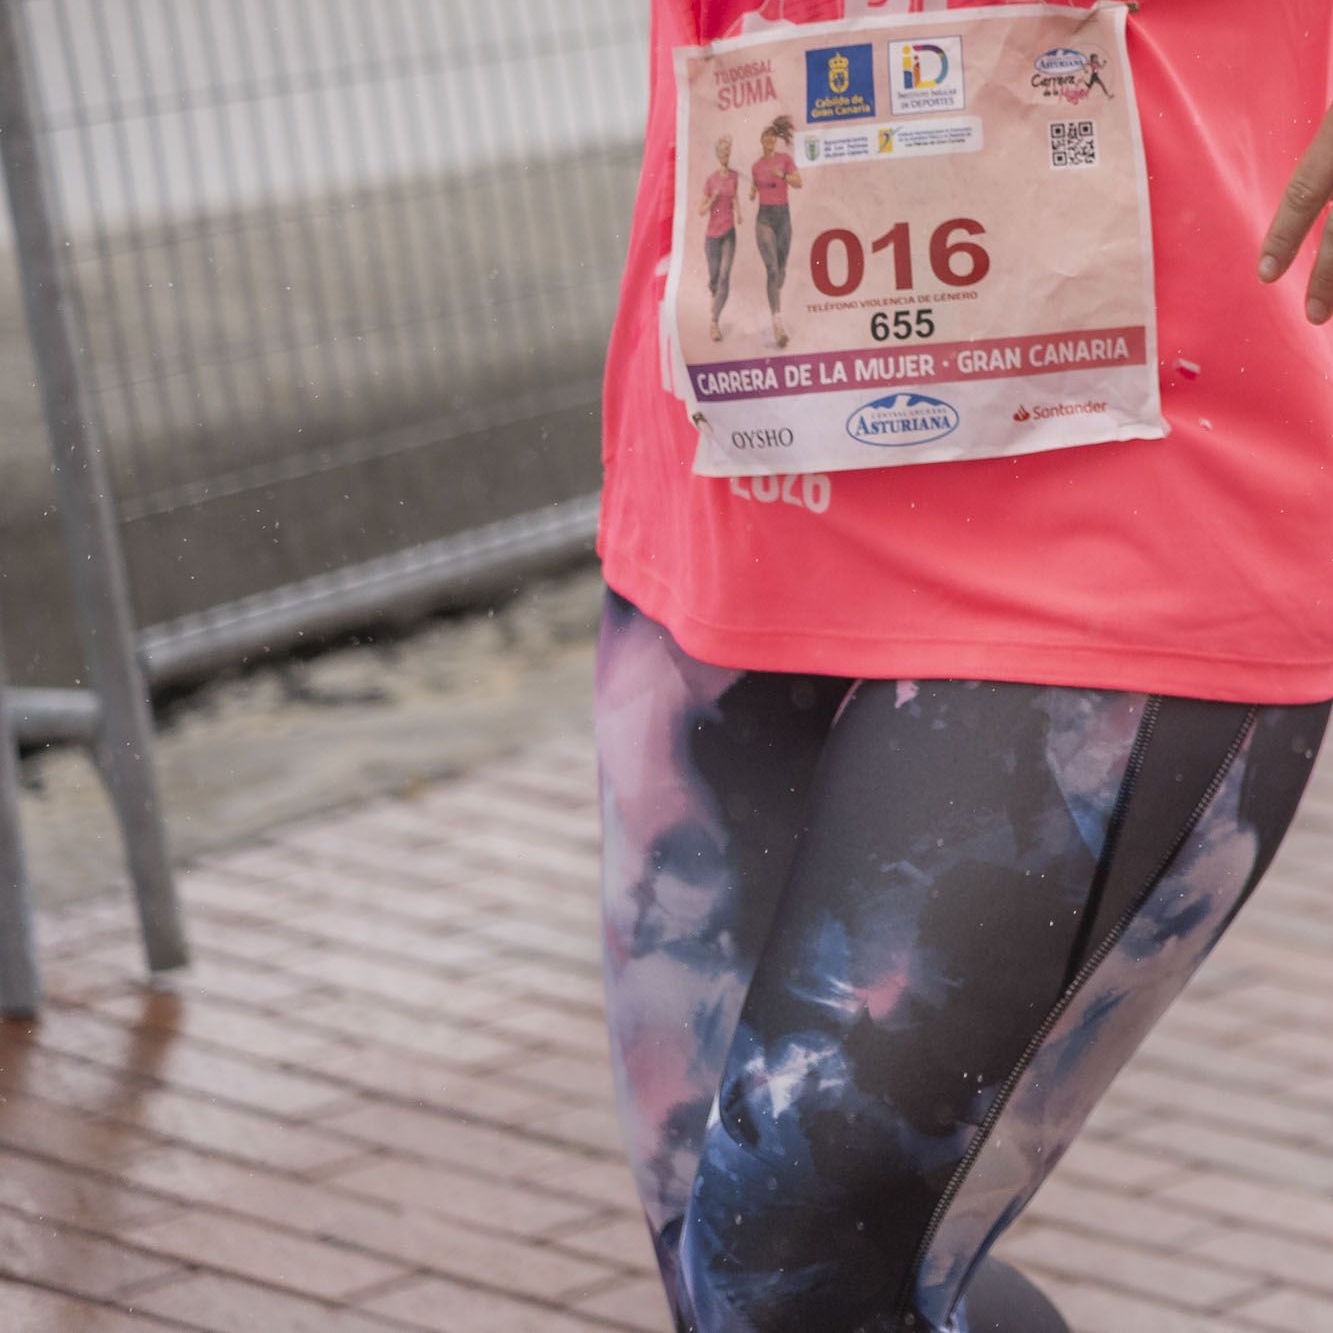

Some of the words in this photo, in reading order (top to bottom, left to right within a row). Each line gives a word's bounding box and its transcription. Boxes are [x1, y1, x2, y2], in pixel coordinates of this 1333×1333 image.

[717, 76, 777, 111] SUMA
[809, 218, 990, 297] 016
[871, 309, 934, 341] 655
[697, 367, 778, 395] CARRERA
[785, 364, 813, 387] DE
[819, 361, 848, 385] LA
[855, 354, 935, 382] MUJER
[957, 347, 1021, 374] GRAN
[1029, 337, 1129, 366] CANARIA
[855, 414, 951, 436] ASTURIANA
[1033, 400, 1107, 420] Santander
[732, 428, 794, 451] OYSHO
